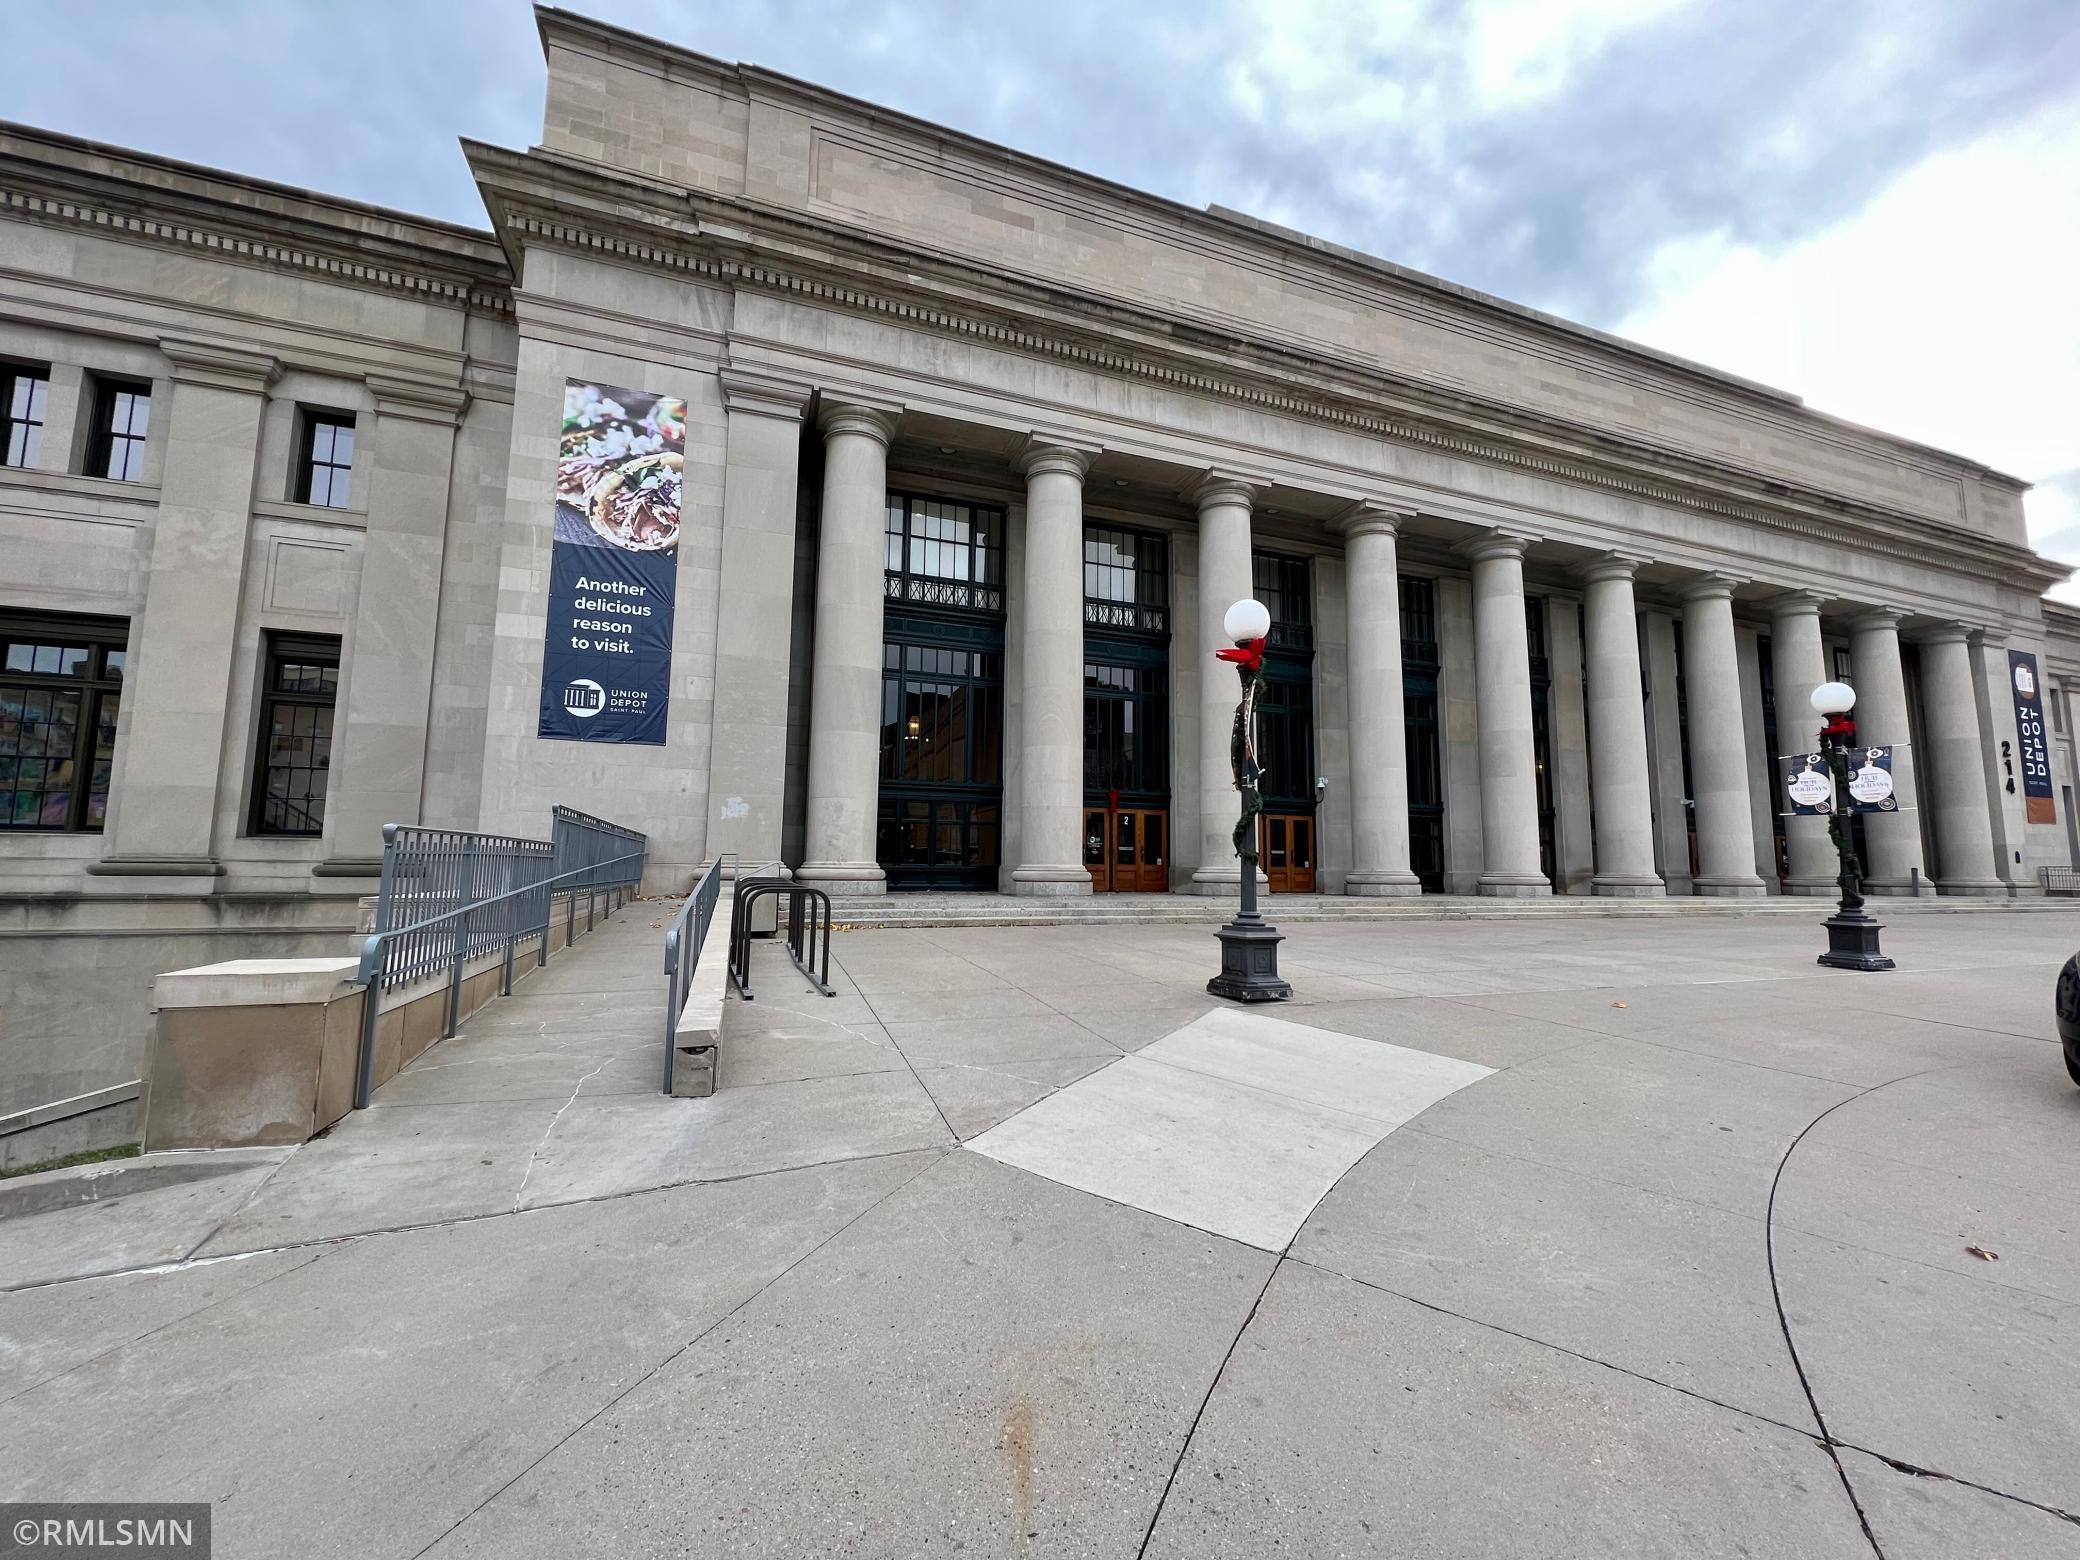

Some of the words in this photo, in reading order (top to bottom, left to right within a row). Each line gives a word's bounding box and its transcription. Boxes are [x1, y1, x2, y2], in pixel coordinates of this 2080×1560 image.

[575, 576, 647, 597] Another
[574, 597, 652, 617] delicious
[573, 617, 633, 634] reason
[571, 636, 590, 650] to
[594, 638, 634, 654] visit.
[610, 698, 647, 708] DEPOT
[611, 689, 648, 699] UNION
[2019, 706, 2036, 775] UNION
[2030, 708, 2047, 776] DEPOT
[2001, 740, 2016, 795] 214
[1124, 815, 1129, 825] 2
